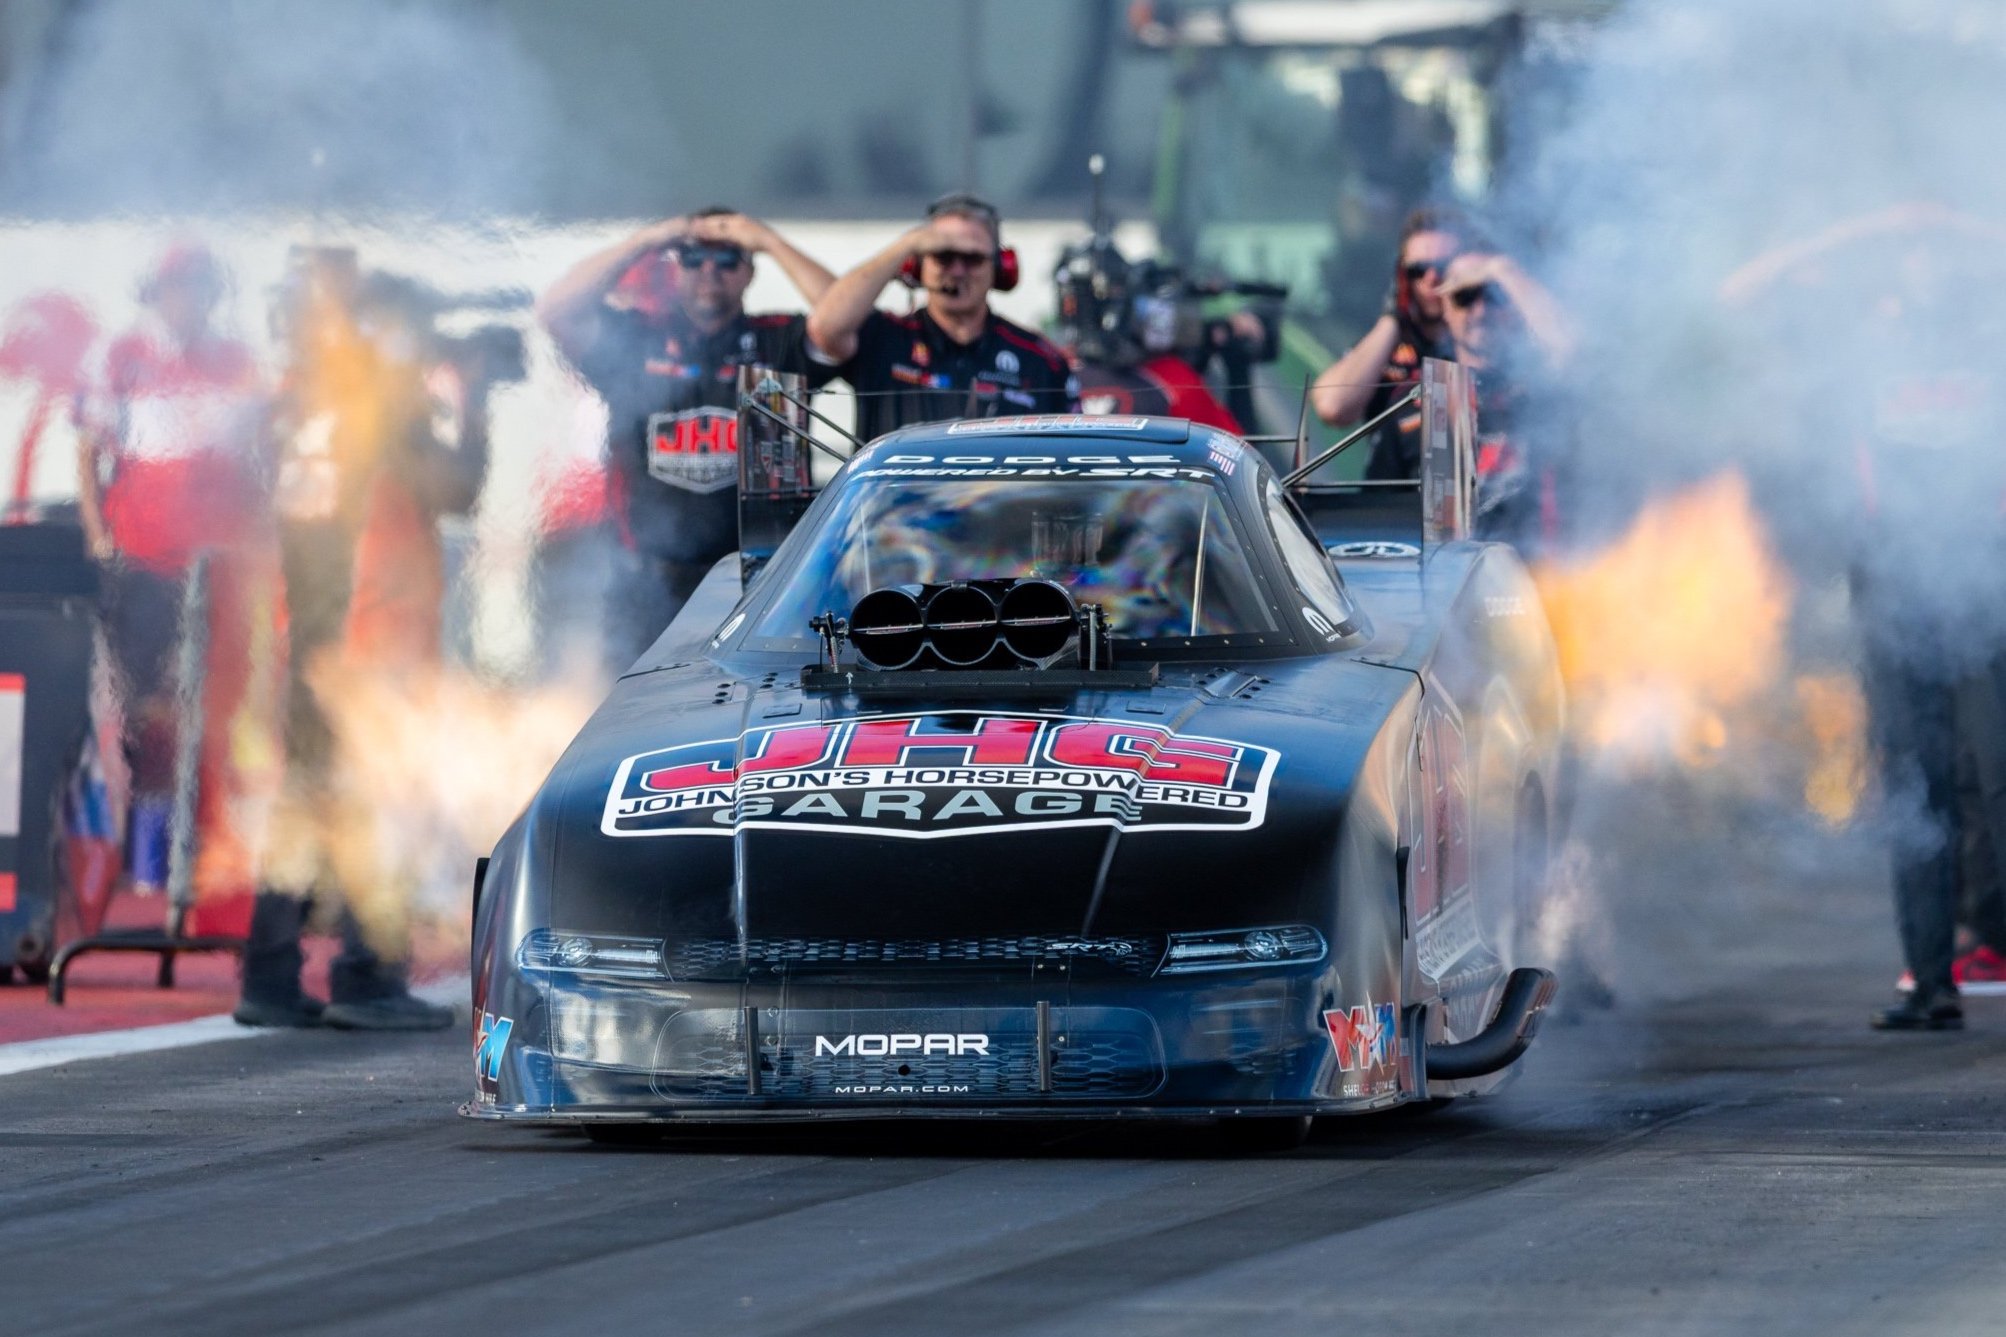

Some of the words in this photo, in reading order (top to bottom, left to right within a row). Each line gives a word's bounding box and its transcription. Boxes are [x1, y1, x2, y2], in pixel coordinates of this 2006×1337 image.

[884, 455, 1181, 464] DODGE
[851, 467, 1018, 481] POWERED
[1021, 467, 1079, 476] BY
[1079, 467, 1216, 479] SRT
[641, 718, 1245, 793] JHG
[618, 770, 870, 815] JOHNSON'S
[883, 769, 1249, 809] HORSEPOWERED
[712, 789, 1143, 825] GARAGE
[815, 1034, 990, 1057] MOPAR
[835, 1085, 969, 1094] MOPAR.COM
